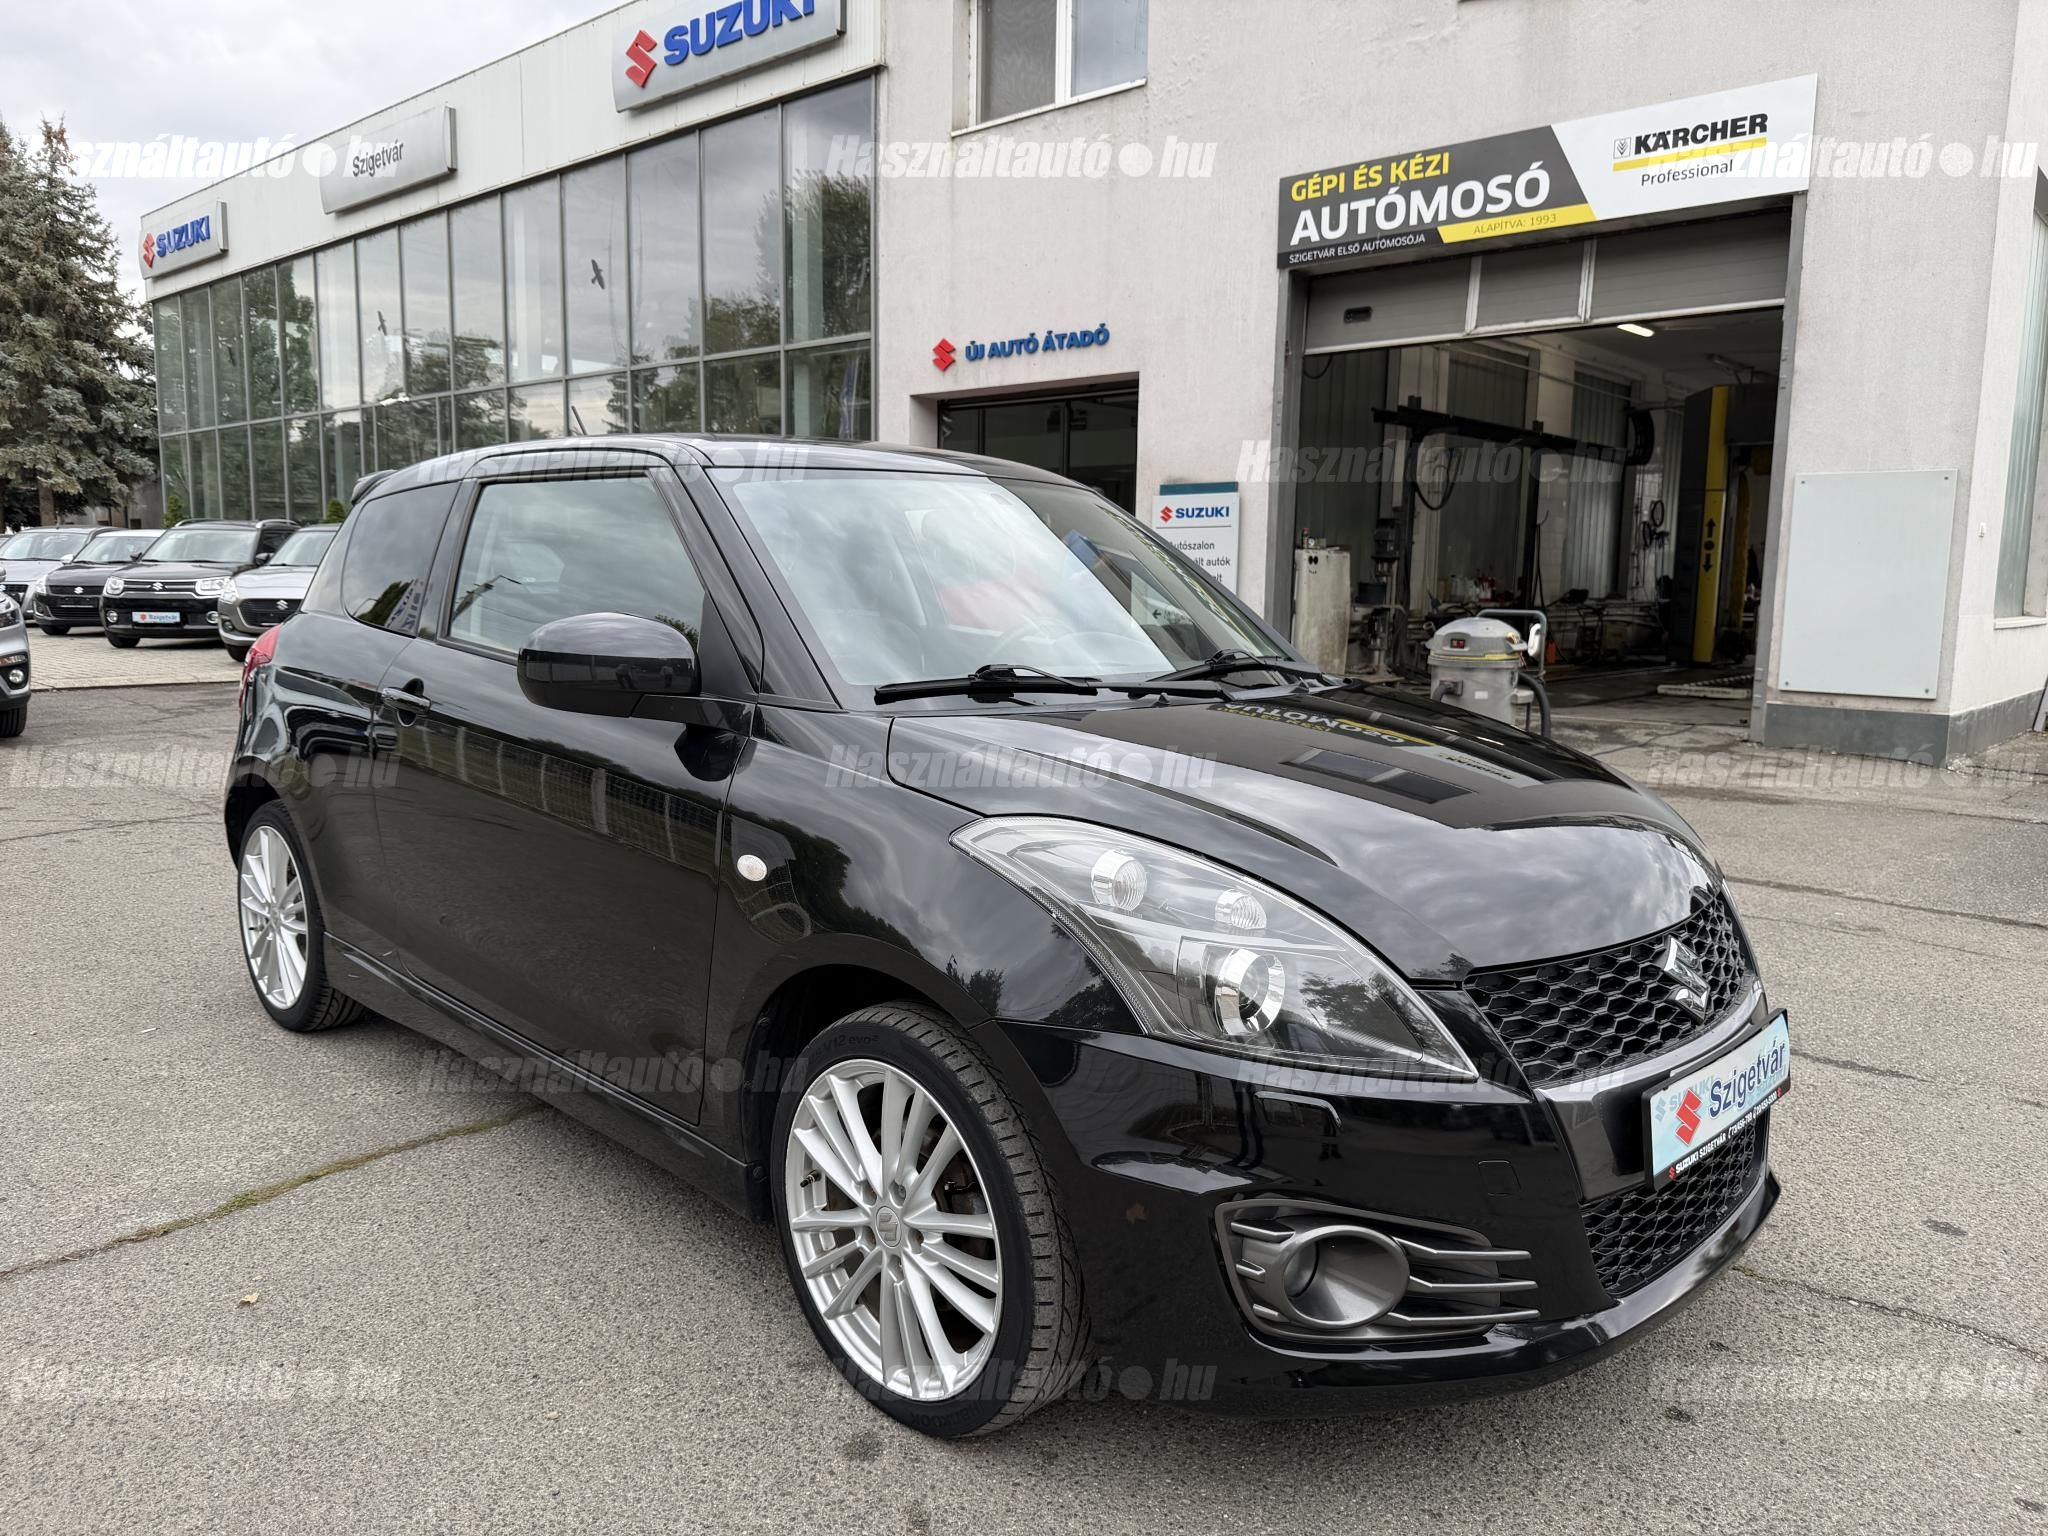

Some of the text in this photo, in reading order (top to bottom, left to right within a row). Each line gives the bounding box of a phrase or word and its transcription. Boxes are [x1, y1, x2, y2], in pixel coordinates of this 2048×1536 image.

[1634, 112, 1768, 156] KÄRCHER
[352, 139, 405, 178] Szigetvár
[1290, 151, 1450, 203] GÉPI ÉS KÉZI
[1640, 157, 1734, 187] Professional
[1289, 160, 1551, 246] AUTÓMOSÓ
[1530, 213, 1557, 227] 1993
[156, 215, 211, 257] SUZUKI
[1289, 246, 1335, 264] SZIGETVÁR
[965, 323, 1110, 361] ÚJ AUTÓ ÁTADÓ
[1175, 506, 1230, 519] SUZUKI
[1170, 540, 1215, 551] utószalon
[1206, 556, 1231, 567] autók
[1710, 1039, 1785, 1117] Szigetvár
